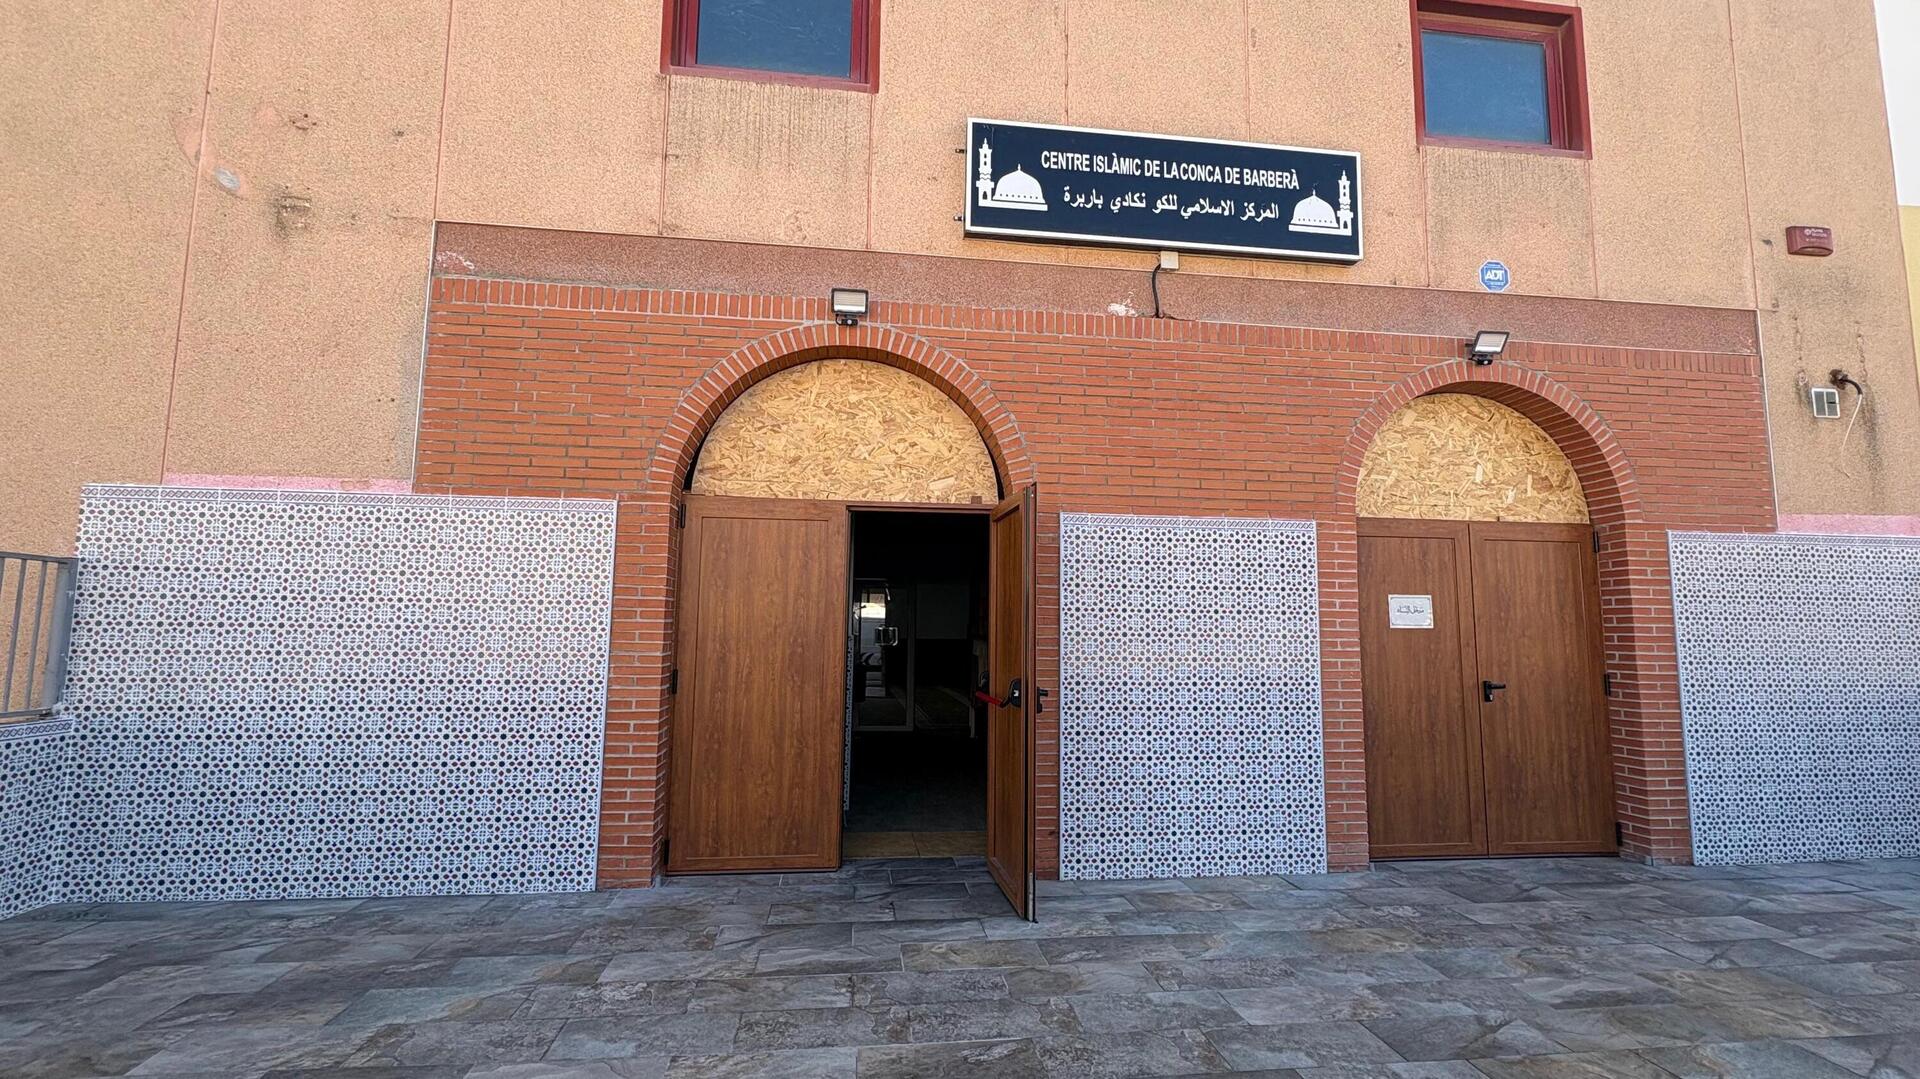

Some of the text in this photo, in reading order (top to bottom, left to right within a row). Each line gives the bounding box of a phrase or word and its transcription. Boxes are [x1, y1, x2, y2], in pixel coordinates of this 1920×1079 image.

[1041, 150, 1090, 172] CENTRE
[1093, 152, 1142, 176] ISLÀMIC
[1144, 159, 1161, 178] DE
[1224, 166, 1241, 185] DE
[1243, 168, 1300, 190] BARBERÀ
[1063, 185, 1104, 209] باربرة
[1180, 197, 1235, 219] الاسلامي
[1240, 202, 1279, 222] المركز
[1485, 269, 1505, 282] ADT
